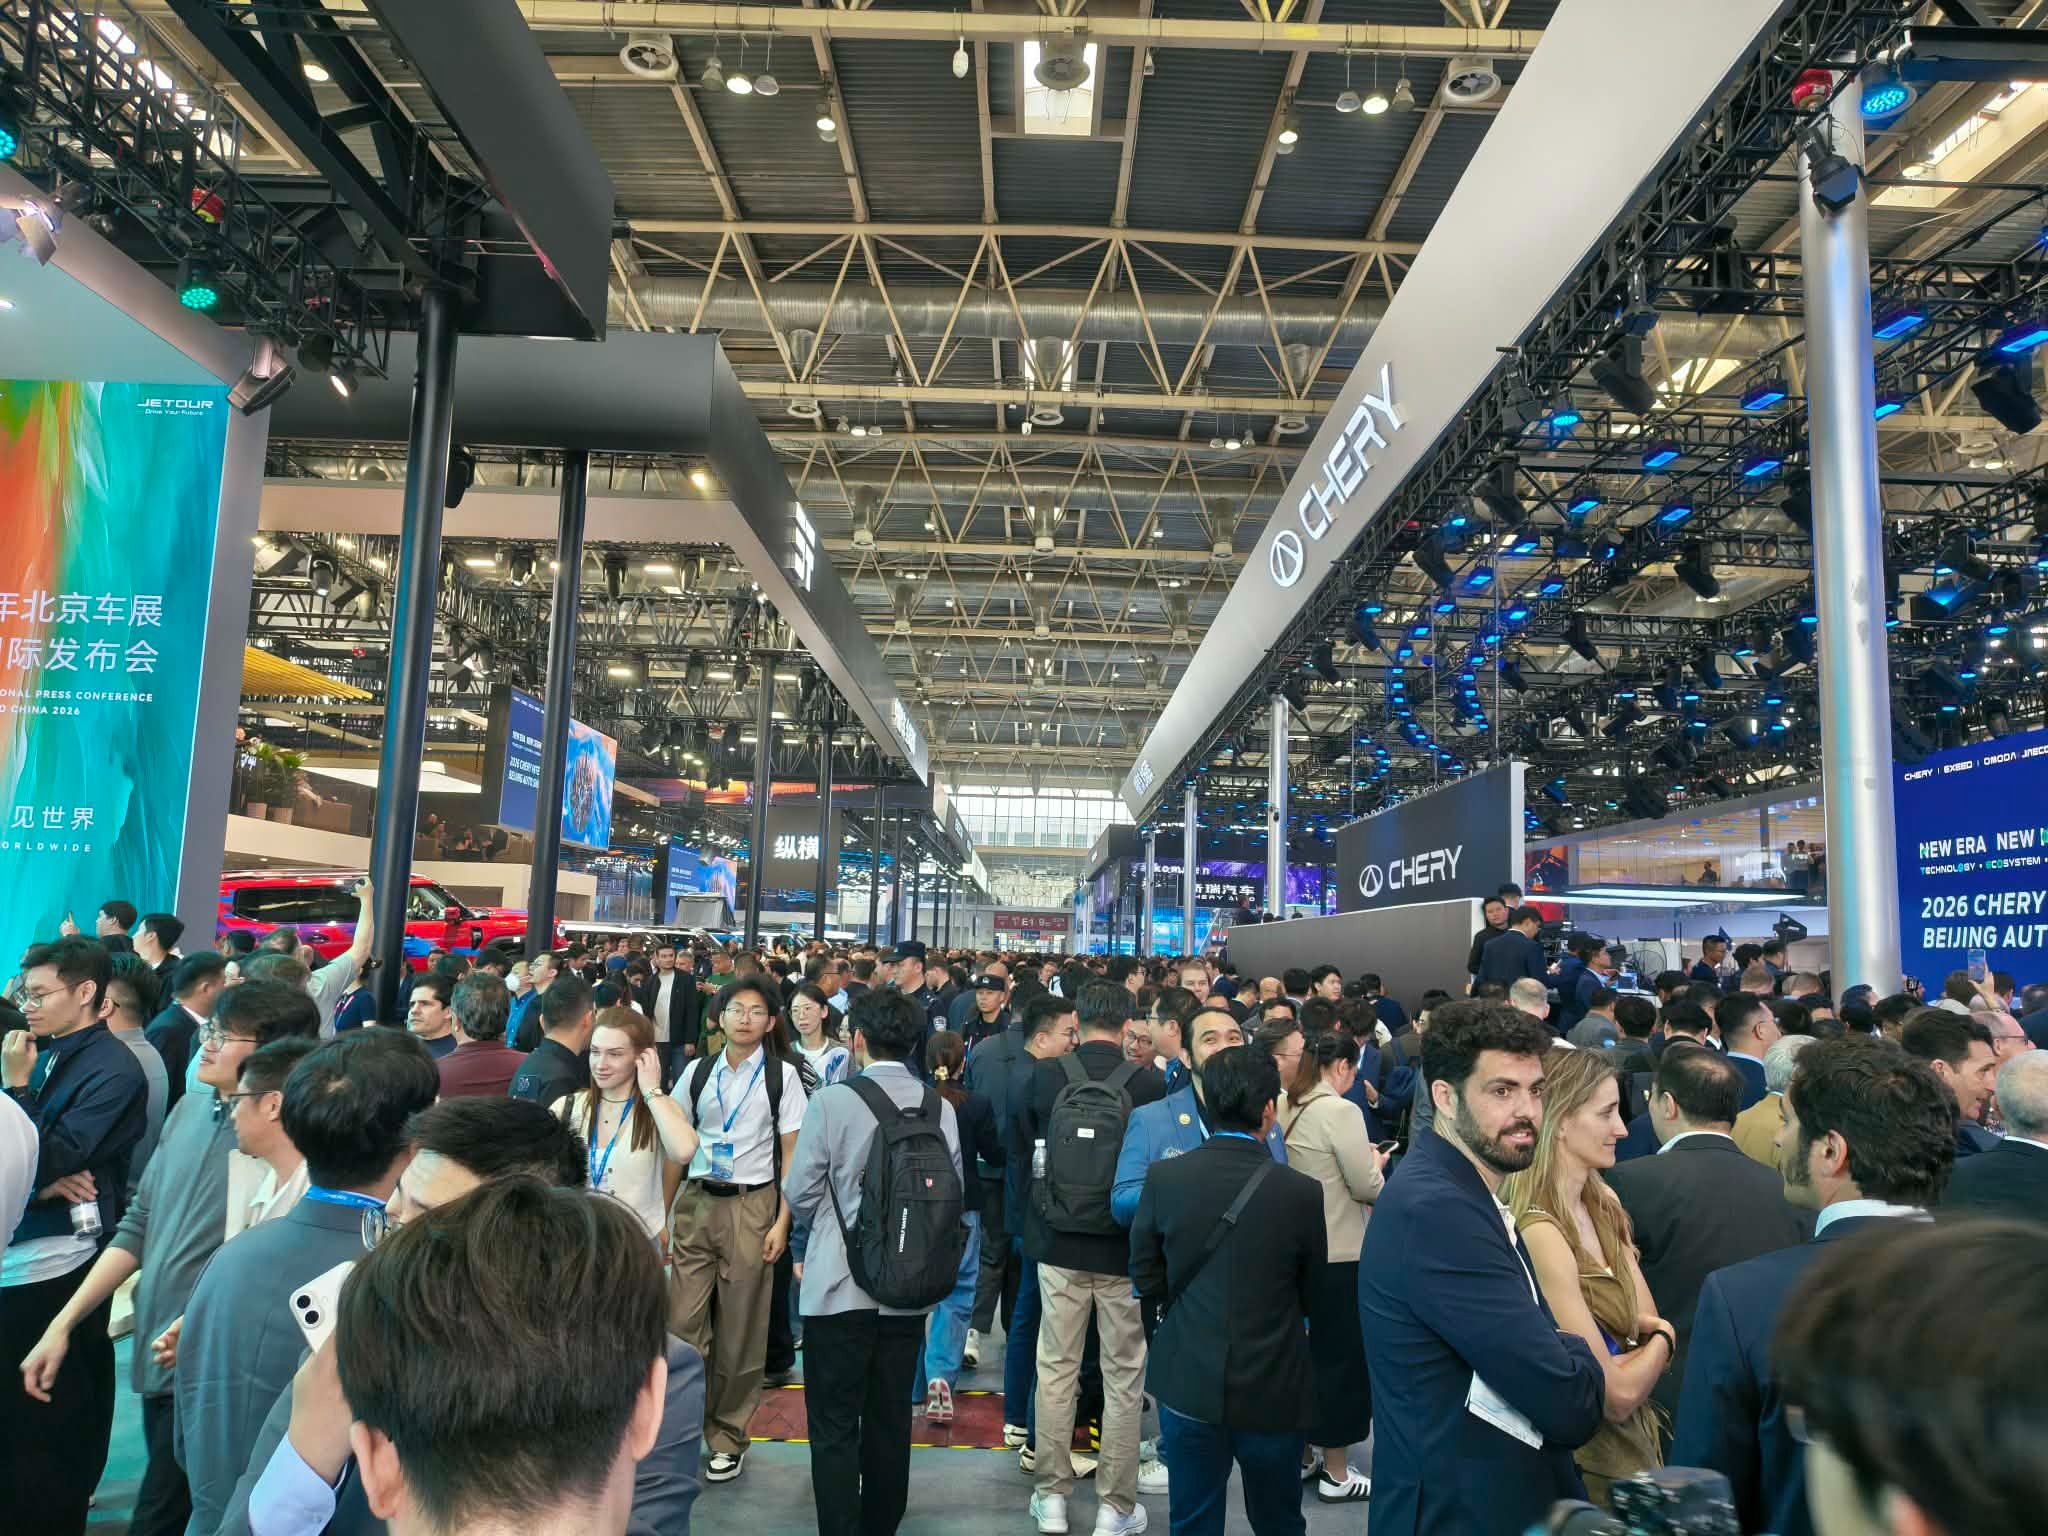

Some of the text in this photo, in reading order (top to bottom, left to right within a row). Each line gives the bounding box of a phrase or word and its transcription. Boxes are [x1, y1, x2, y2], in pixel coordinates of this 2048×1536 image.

[137, 398, 214, 408] JETOUR
[1299, 363, 1401, 540] CHERY
[0, 637, 159, 673] 际发布会
[36, 689, 71, 700] PRESS
[75, 691, 153, 702] CONFERENCE
[11, 704, 48, 714] CHINA
[52, 706, 80, 716] 2026
[1904, 768, 1933, 781] CHERY
[1943, 760, 1973, 773] EXEED
[1983, 752, 2017, 766] OMODA
[11, 805, 95, 831] 见世界
[0, 841, 91, 853] ORLDWIDE
[773, 834, 819, 860] 纵横
[1919, 840, 1952, 859] NEW
[1956, 836, 1987, 855] ERA
[1996, 829, 2035, 851] NEW
[1389, 845, 1463, 890] CHERY
[1920, 856, 2041, 875] TECHNOLOGY ECOSYSTEM
[1921, 891, 2047, 919] 2026 CHERY
[1923, 923, 2048, 949] BEIJING AUT
